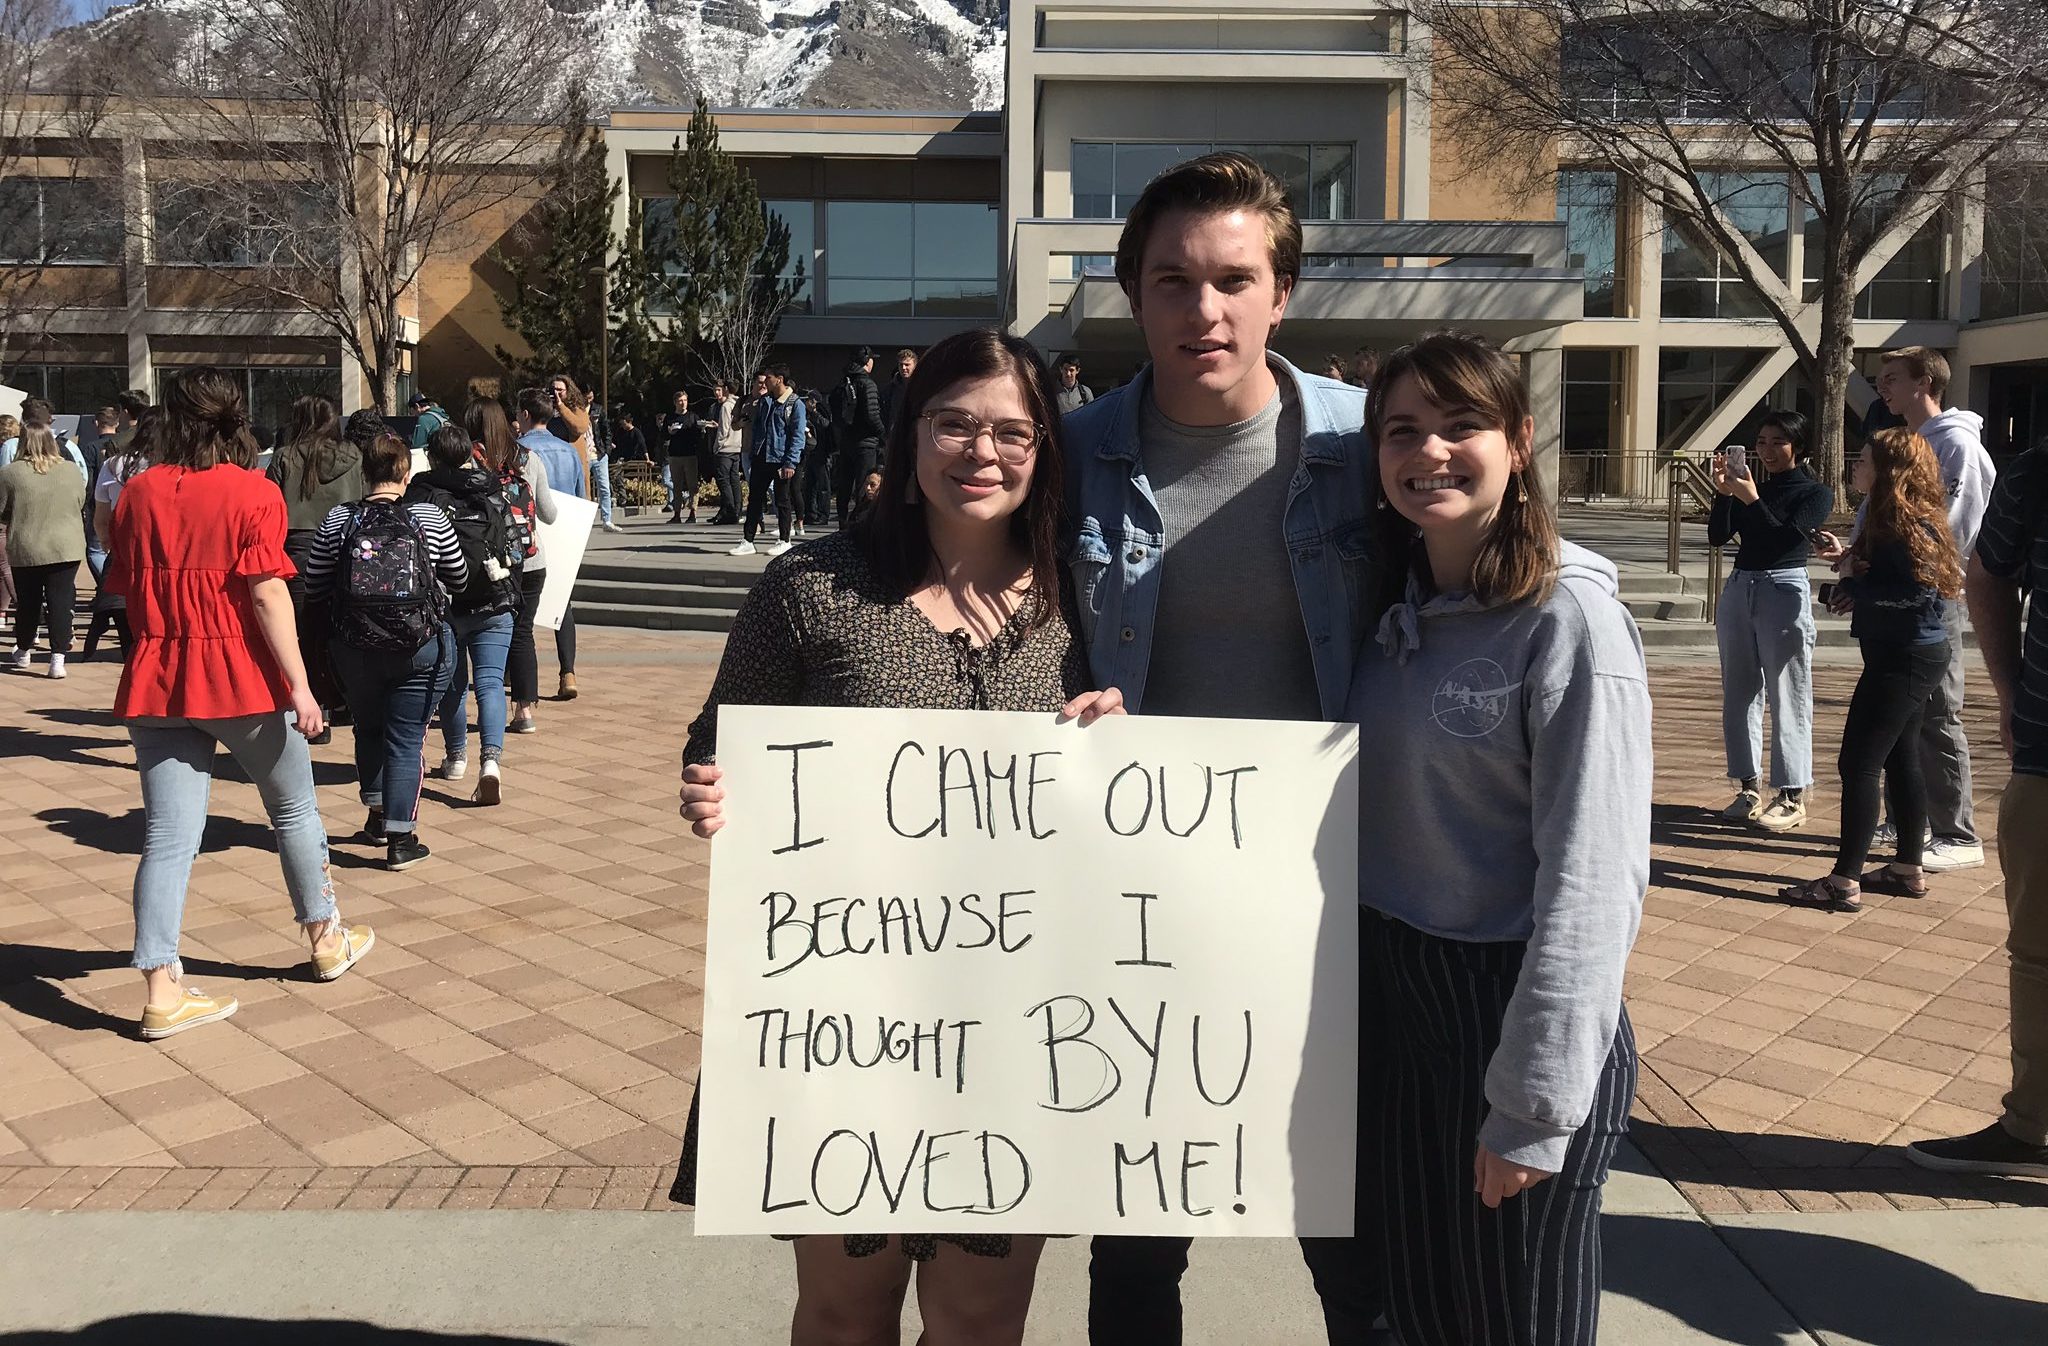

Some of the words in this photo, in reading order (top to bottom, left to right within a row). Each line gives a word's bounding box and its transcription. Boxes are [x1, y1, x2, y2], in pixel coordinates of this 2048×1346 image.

[1442, 680, 1500, 717] NASA
[766, 739, 834, 855] I
[885, 740, 1063, 840] CAME
[1104, 760, 1259, 850] OUT
[759, 889, 1037, 979] BECAUSE
[1114, 892, 1177, 970] I
[744, 1007, 983, 1094] THOUGHT
[1023, 994, 1254, 1120] BYU
[761, 1116, 1033, 1217] LOVED
[1113, 1122, 1247, 1218] ME!
